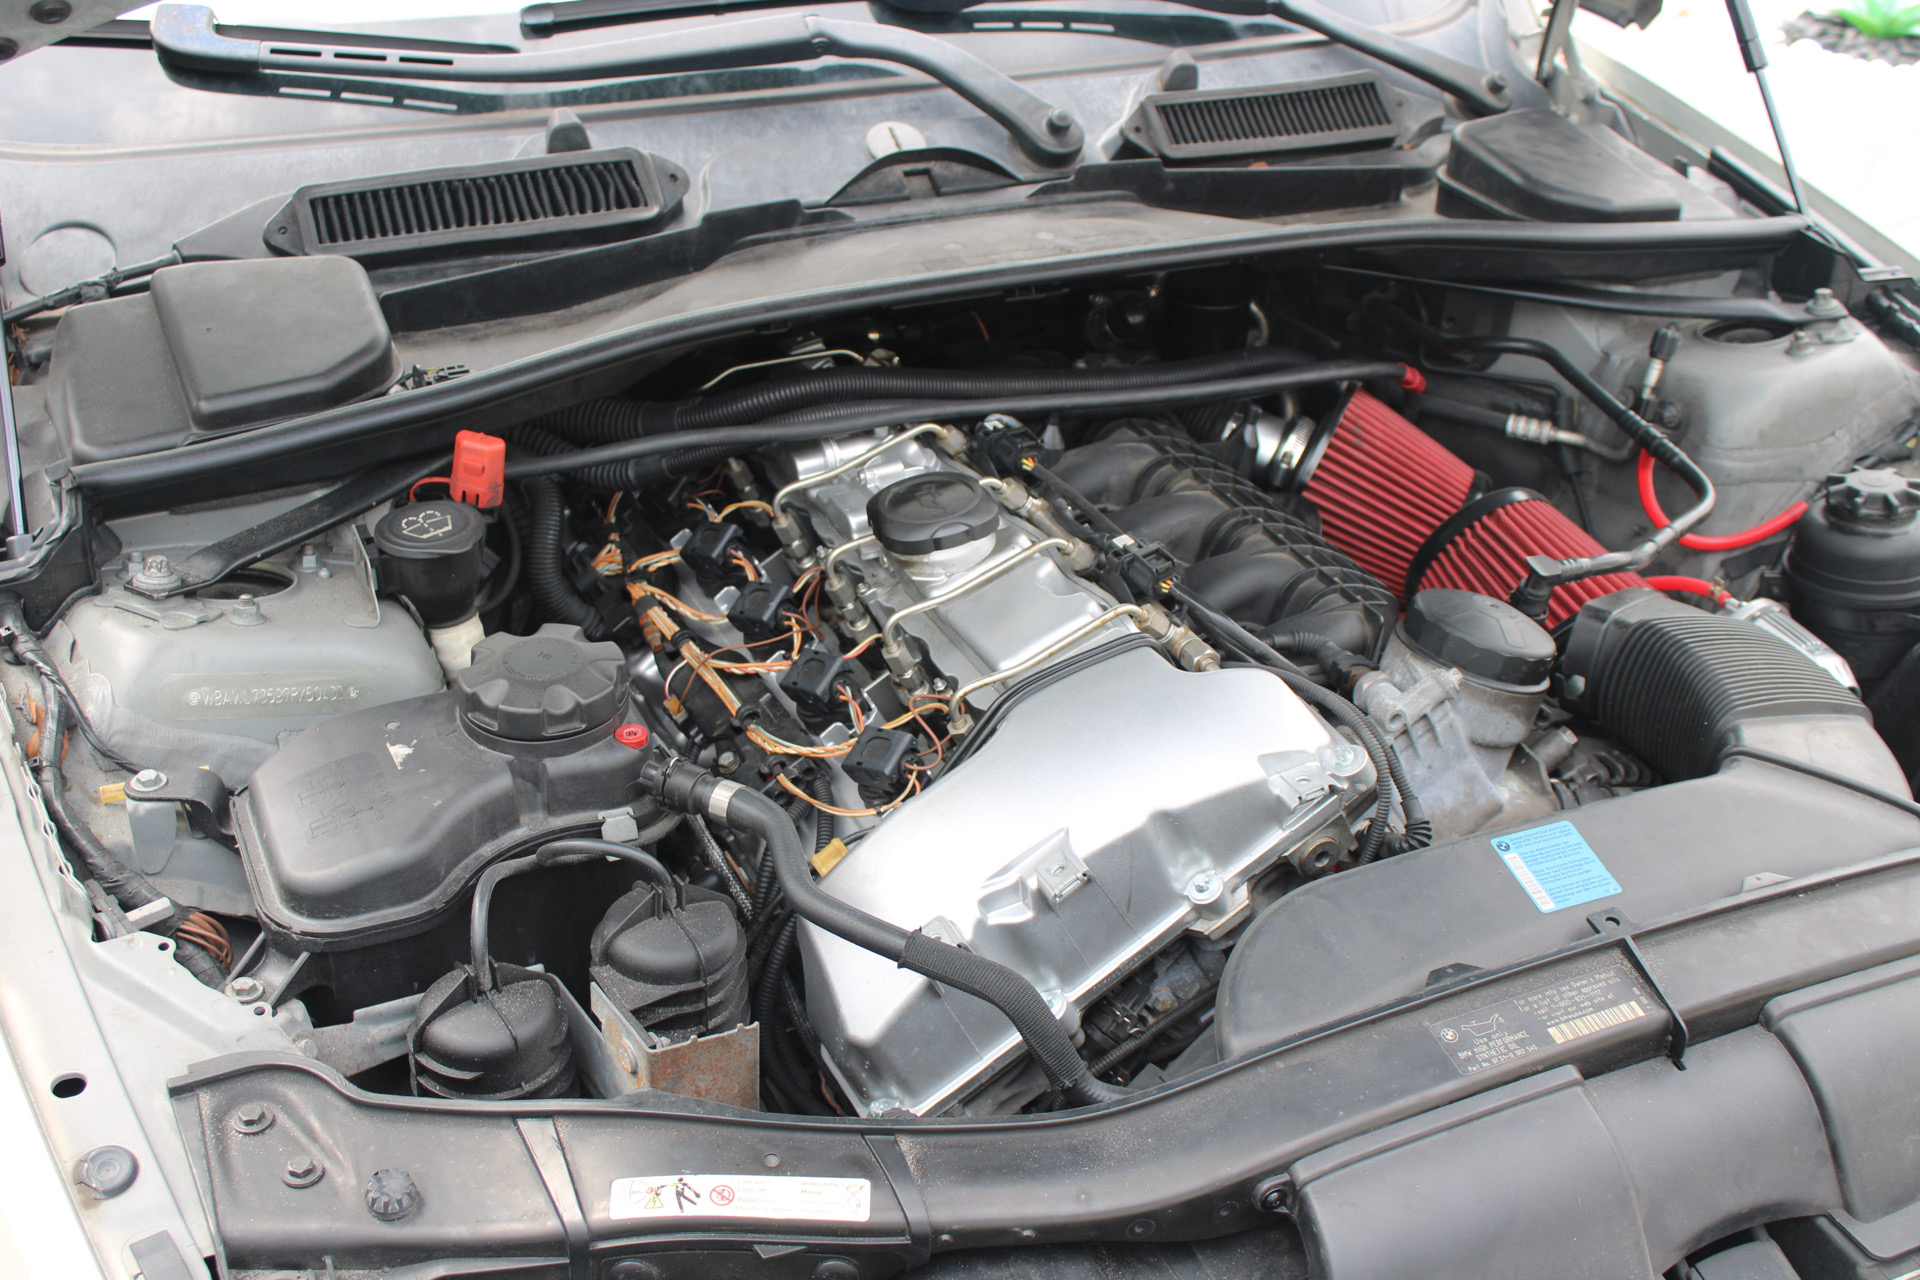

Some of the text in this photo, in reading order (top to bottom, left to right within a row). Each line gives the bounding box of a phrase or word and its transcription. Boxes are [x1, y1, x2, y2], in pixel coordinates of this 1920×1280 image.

[1538, 998, 1551, 1006] list
[1562, 990, 1578, 999] other
[1581, 981, 1607, 993] approved
[1551, 1009, 1566, 1017] visit
[1458, 1031, 1529, 1059] BMW HIGH PERFORMANCE
[1491, 1031, 1508, 1041] only
[1476, 1042, 1520, 1061] SYNTHETIC OIL
